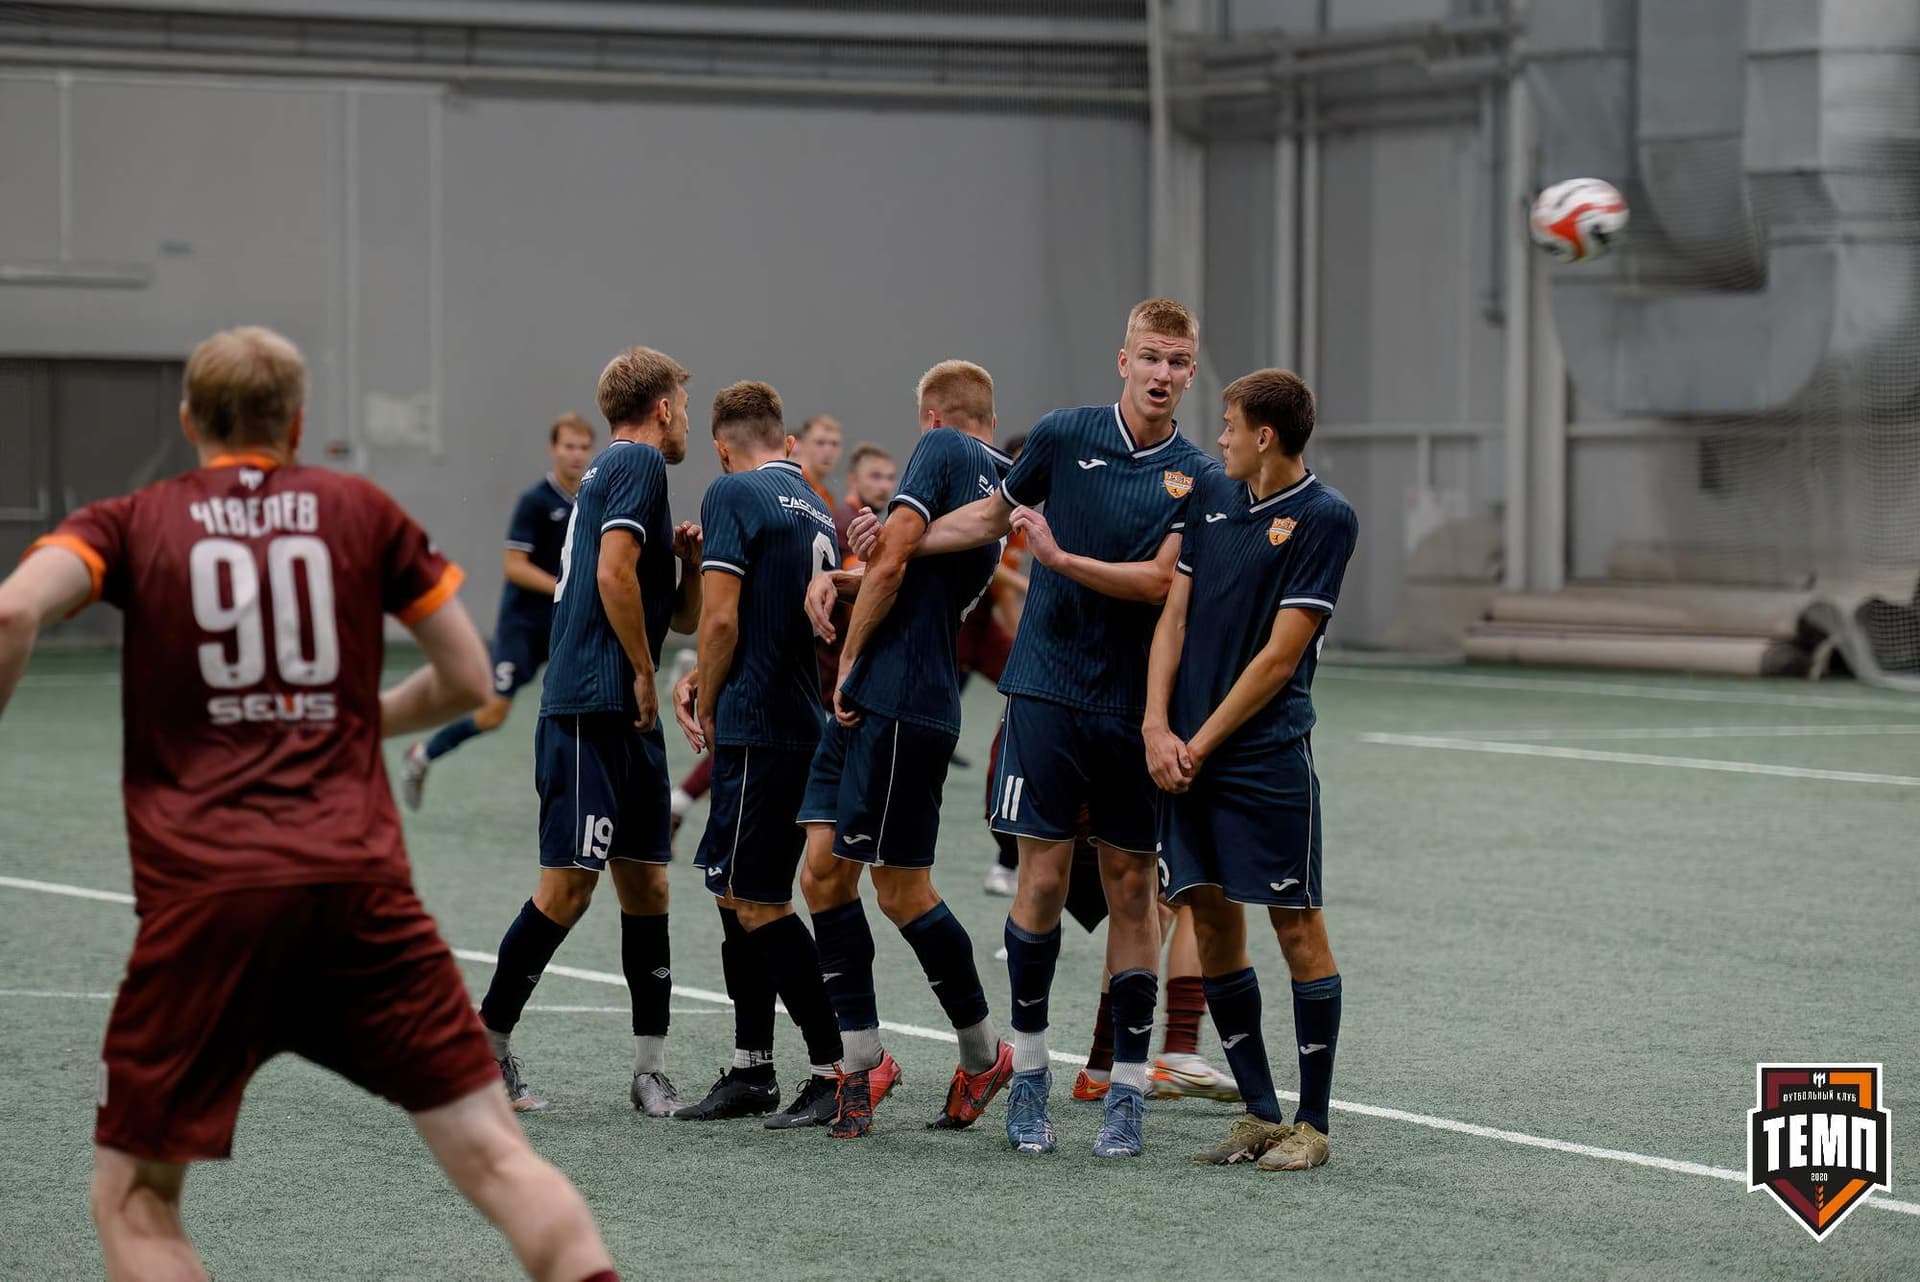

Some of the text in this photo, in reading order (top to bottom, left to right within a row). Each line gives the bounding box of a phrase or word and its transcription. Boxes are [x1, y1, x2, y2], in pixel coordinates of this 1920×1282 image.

[189, 491, 318, 537] ЧЕВЕЛЕВ
[189, 535, 340, 689] 90
[207, 693, 337, 725] SEUS
[1001, 775, 1024, 821] 11
[582, 814, 613, 859] 19
